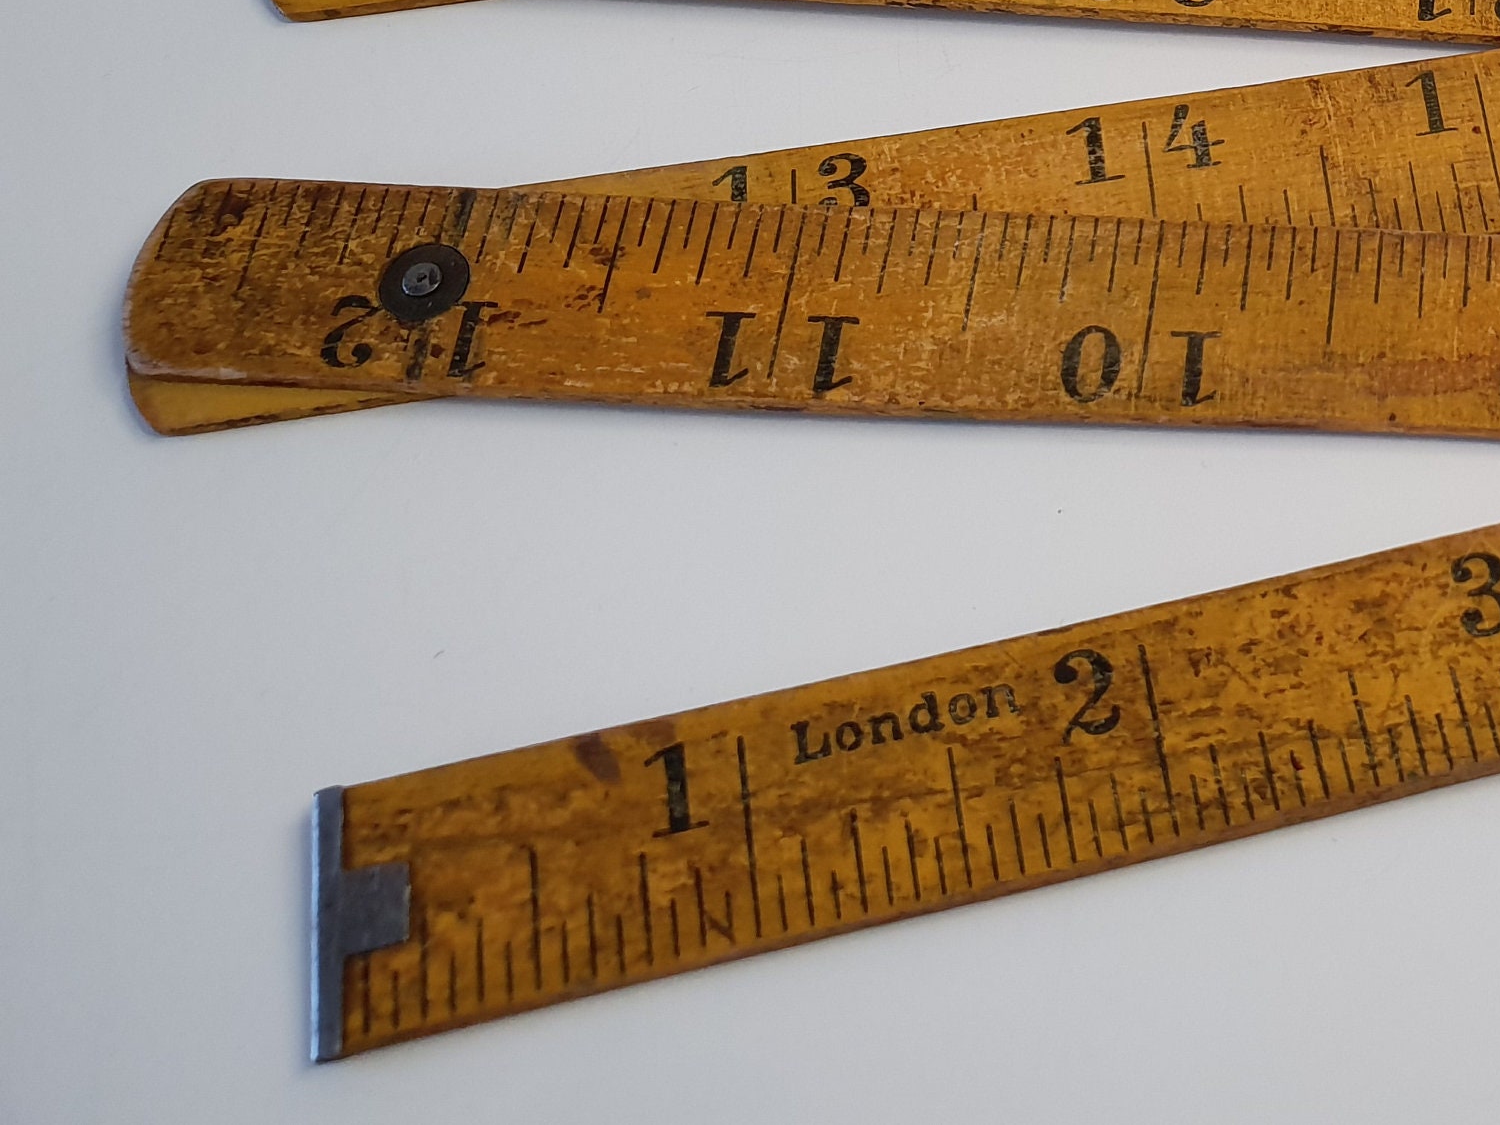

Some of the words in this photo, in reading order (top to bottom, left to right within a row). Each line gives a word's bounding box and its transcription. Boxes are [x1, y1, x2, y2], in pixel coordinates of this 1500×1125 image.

[1067, 104, 1226, 185] 14
[320, 295, 498, 378] 12
[706, 312, 860, 393] 11
[1060, 325, 1222, 407] 10
[790, 682, 1020, 764] London
[1053, 649, 1121, 745] 2
[645, 742, 709, 838] 1
